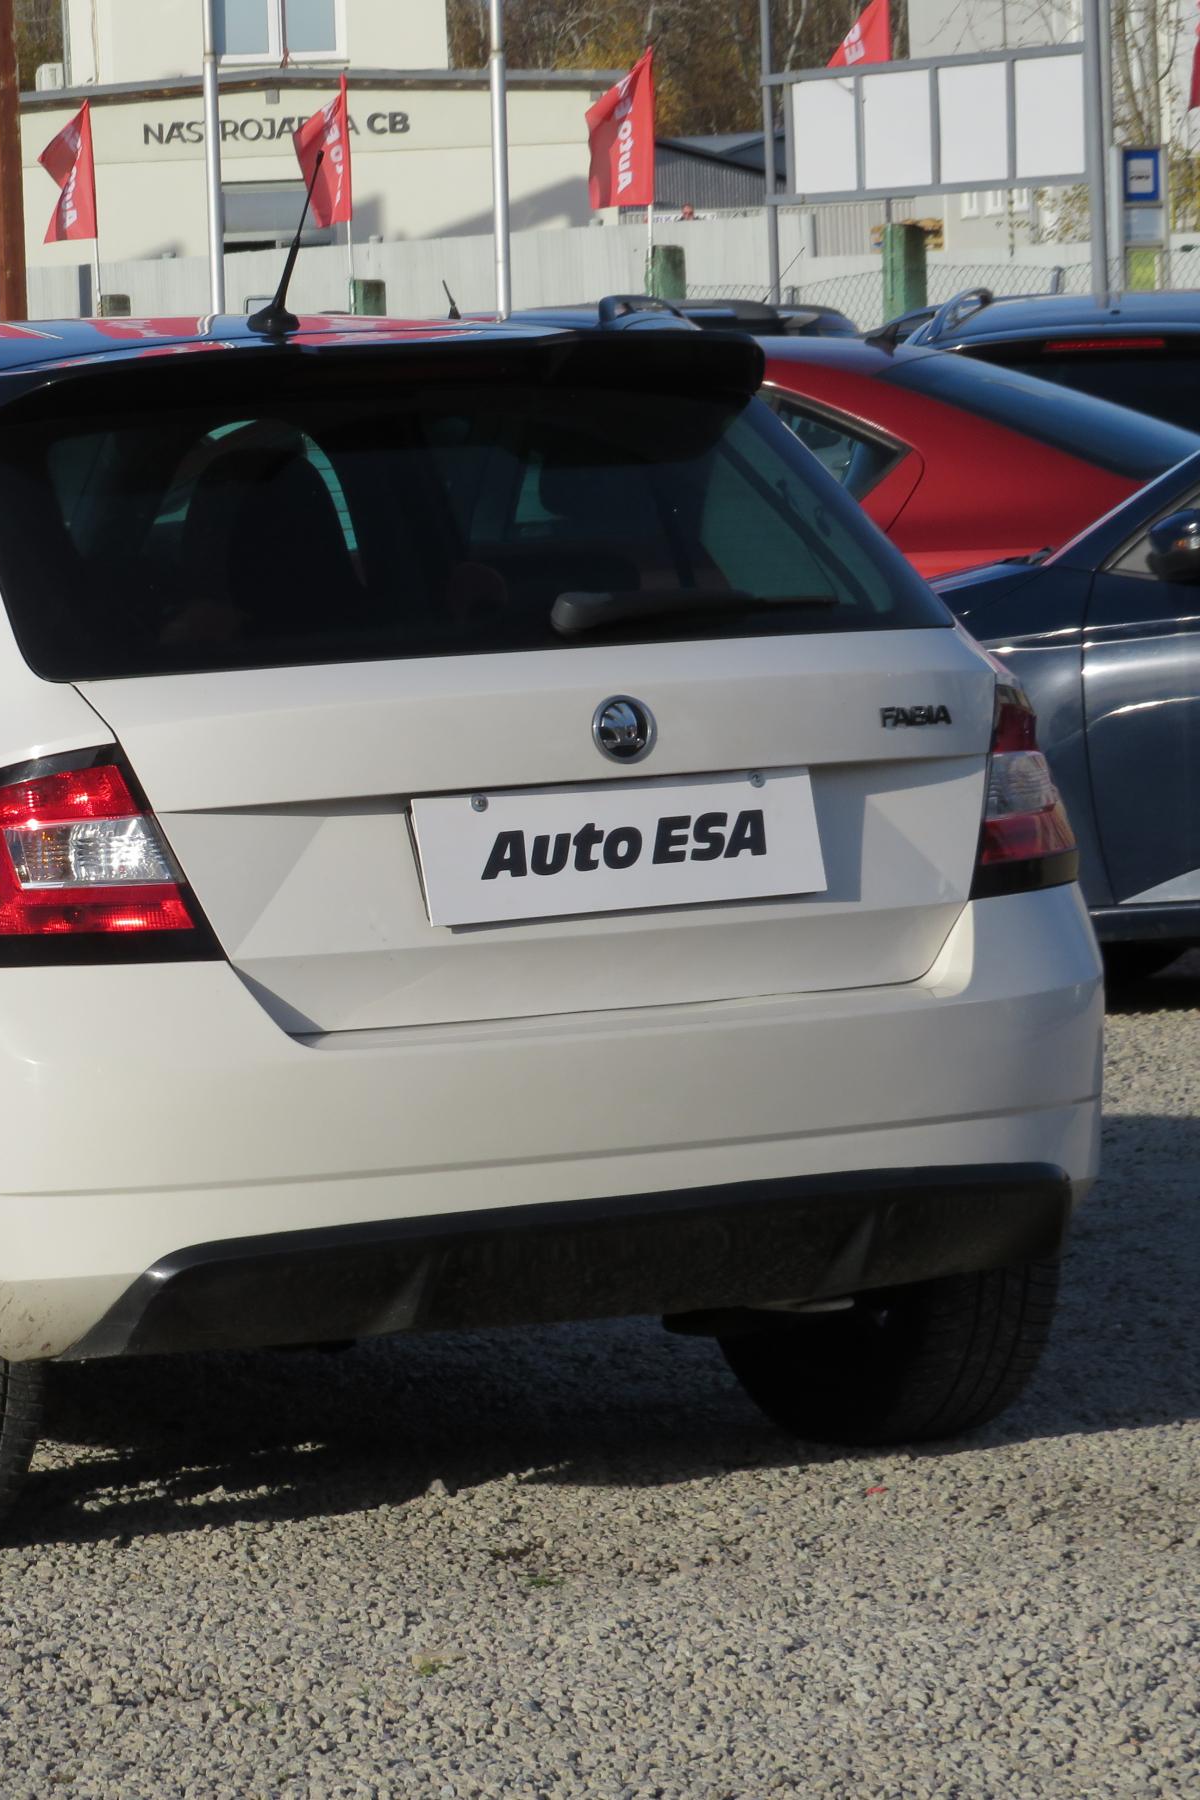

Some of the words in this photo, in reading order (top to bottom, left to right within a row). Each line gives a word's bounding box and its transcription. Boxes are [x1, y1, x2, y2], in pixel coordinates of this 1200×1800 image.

[366, 111, 411, 135] CB
[879, 704, 952, 728] FABIA
[480, 822, 643, 881] Auto
[652, 809, 767, 865] ESA
